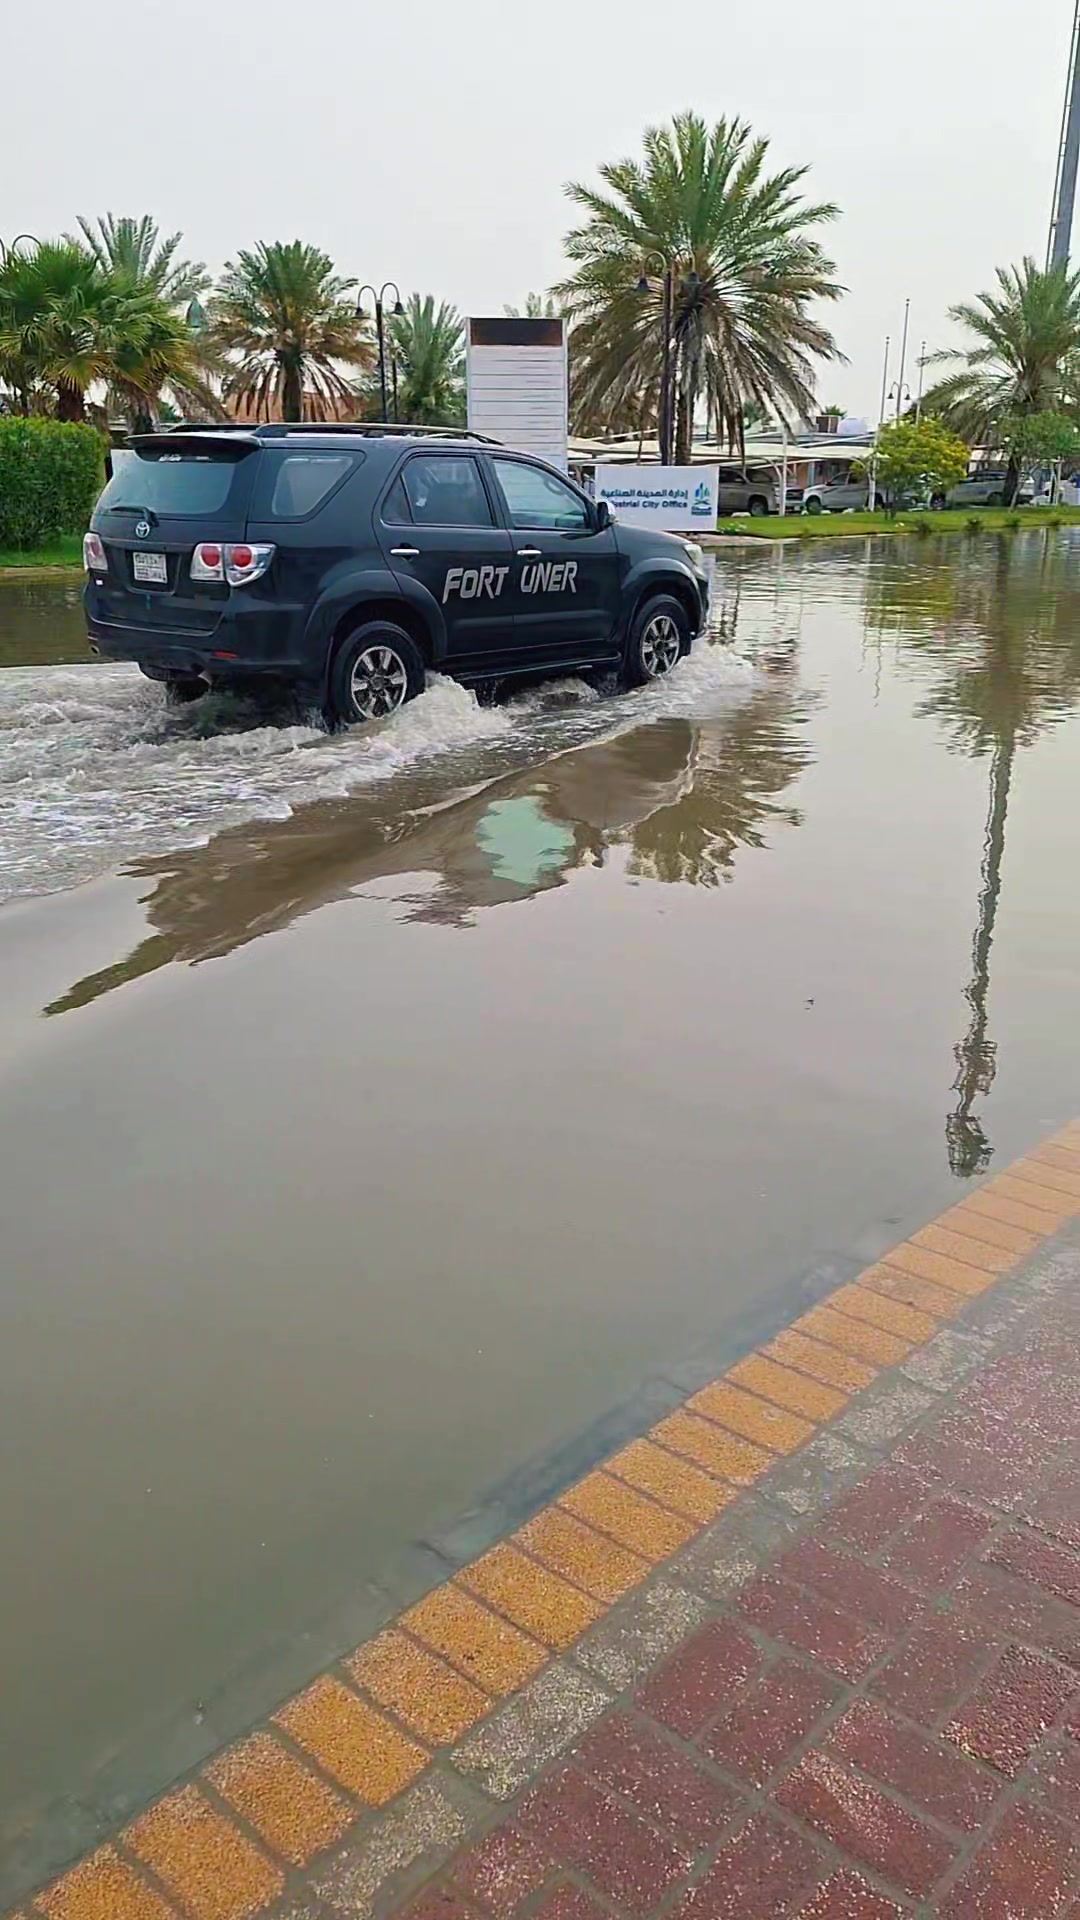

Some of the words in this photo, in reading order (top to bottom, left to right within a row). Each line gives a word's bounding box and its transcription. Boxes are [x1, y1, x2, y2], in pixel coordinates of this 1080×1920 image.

[642, 500, 660, 509] City
[662, 500, 688, 508] Office
[442, 565, 510, 604] FORT
[520, 561, 578, 594] UNER
